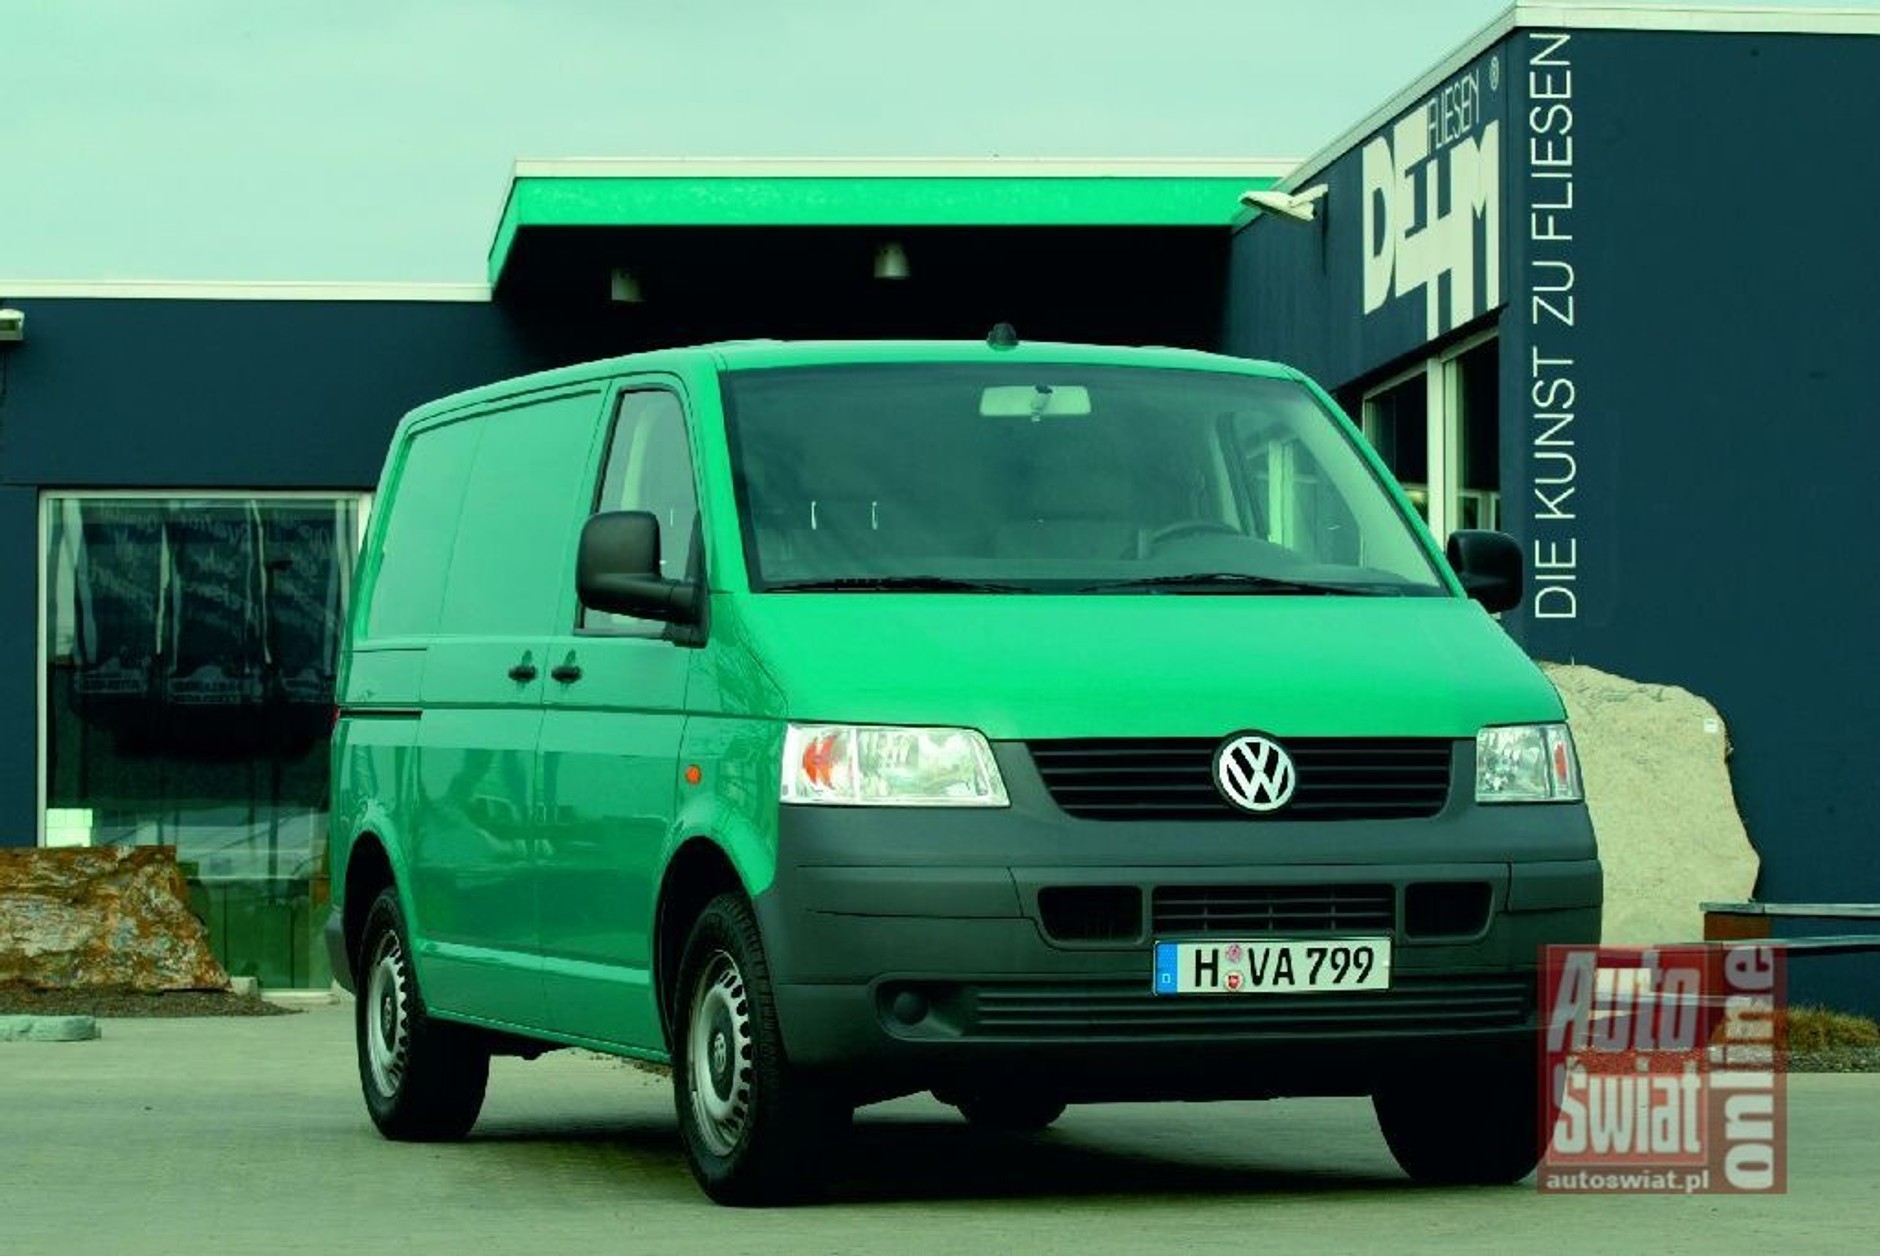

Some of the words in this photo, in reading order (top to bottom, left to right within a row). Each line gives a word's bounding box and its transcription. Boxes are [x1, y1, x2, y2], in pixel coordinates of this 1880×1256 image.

[1529, 33, 1573, 240] FLIESEN
[1362, 103, 1499, 341] DEHM
[1532, 261, 1575, 326] ZU
[1532, 346, 1576, 519] KUNST
[1535, 538, 1576, 618] DIE
[1195, 949, 1219, 987] H
[1248, 948, 1295, 986] VA
[1306, 947, 1374, 985] 799
